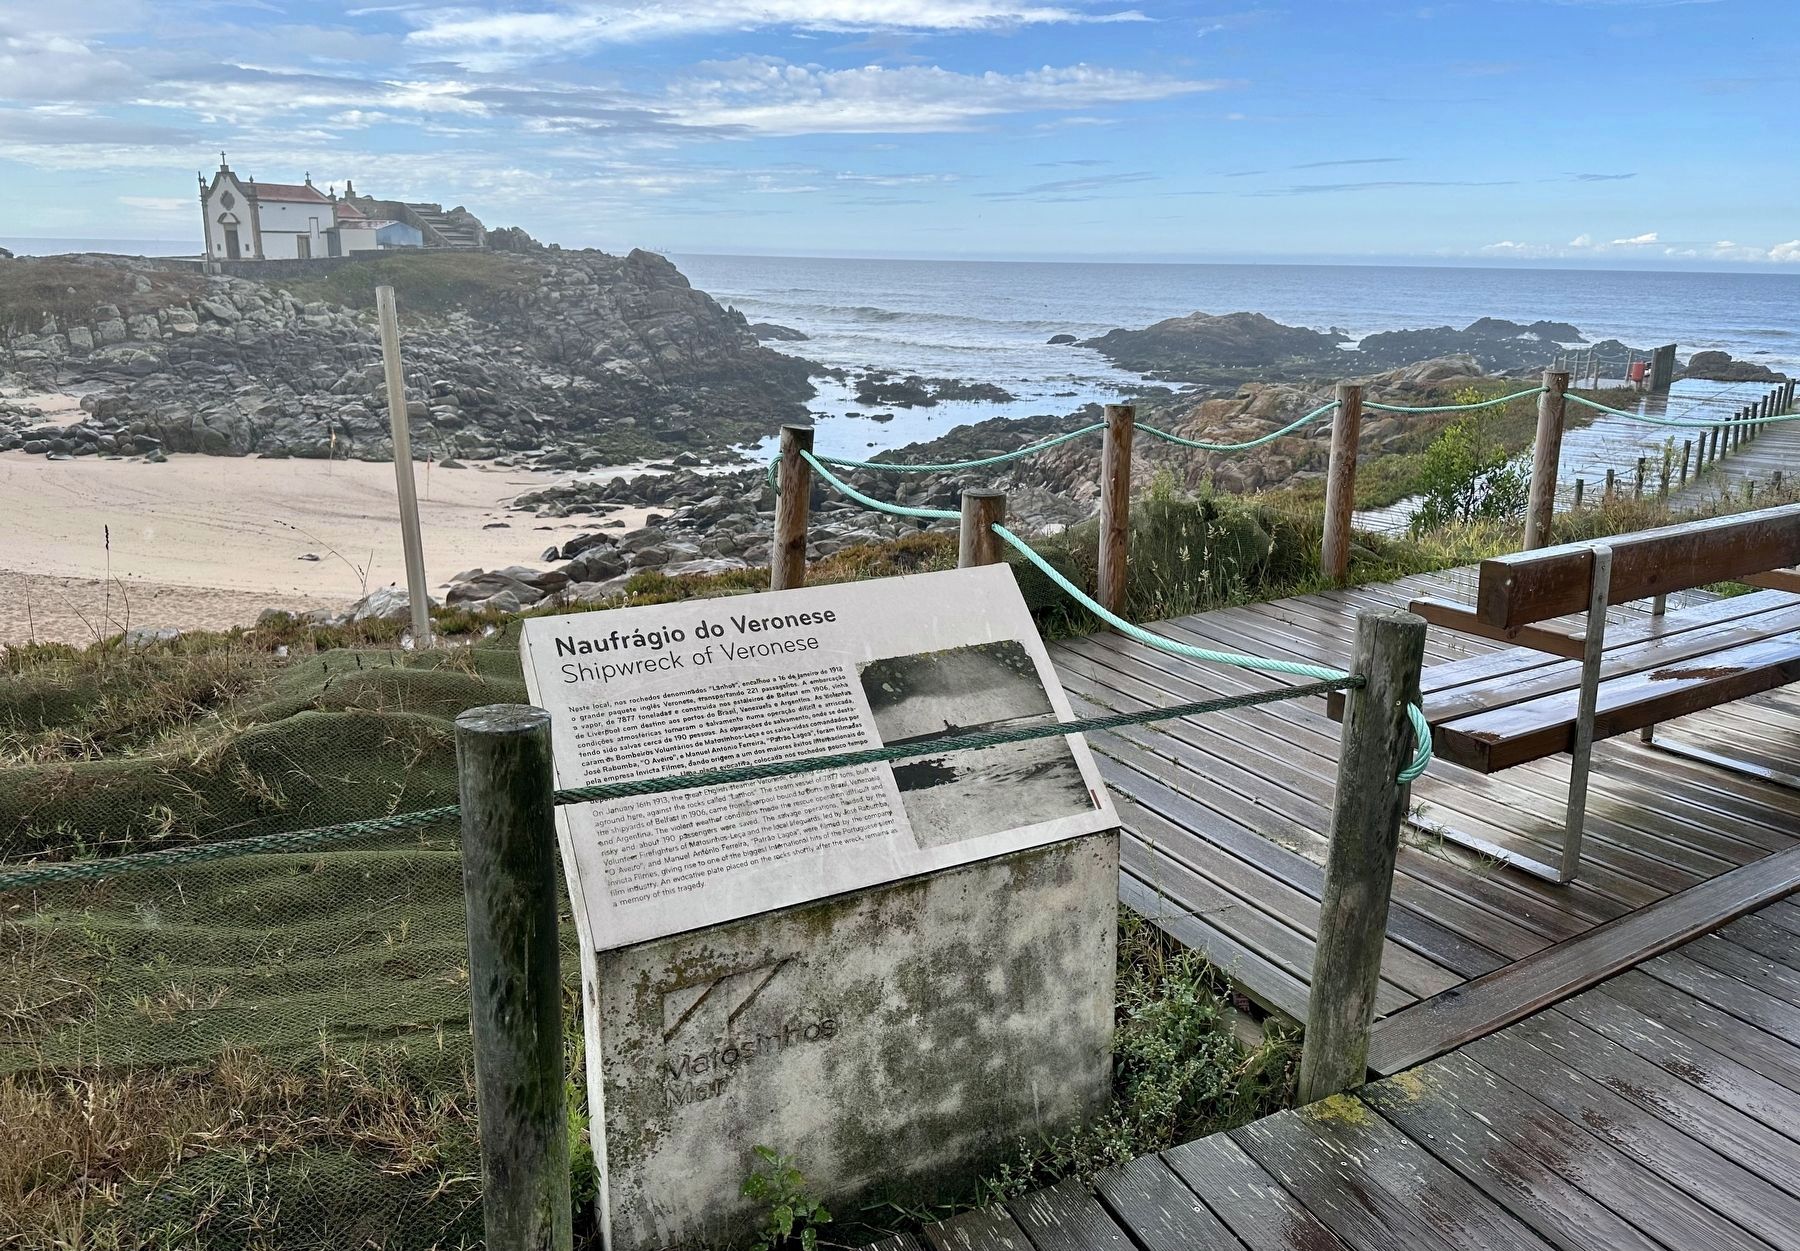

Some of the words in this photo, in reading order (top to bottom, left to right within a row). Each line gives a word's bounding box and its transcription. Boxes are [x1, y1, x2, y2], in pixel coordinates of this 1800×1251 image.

[555, 627, 686, 658] Naufrágio
[694, 620, 725, 640] do
[730, 609, 837, 634] Veronese
[561, 651, 684, 684] Shipwreck
[693, 646, 714, 666] of
[720, 637, 819, 661] Veronese
